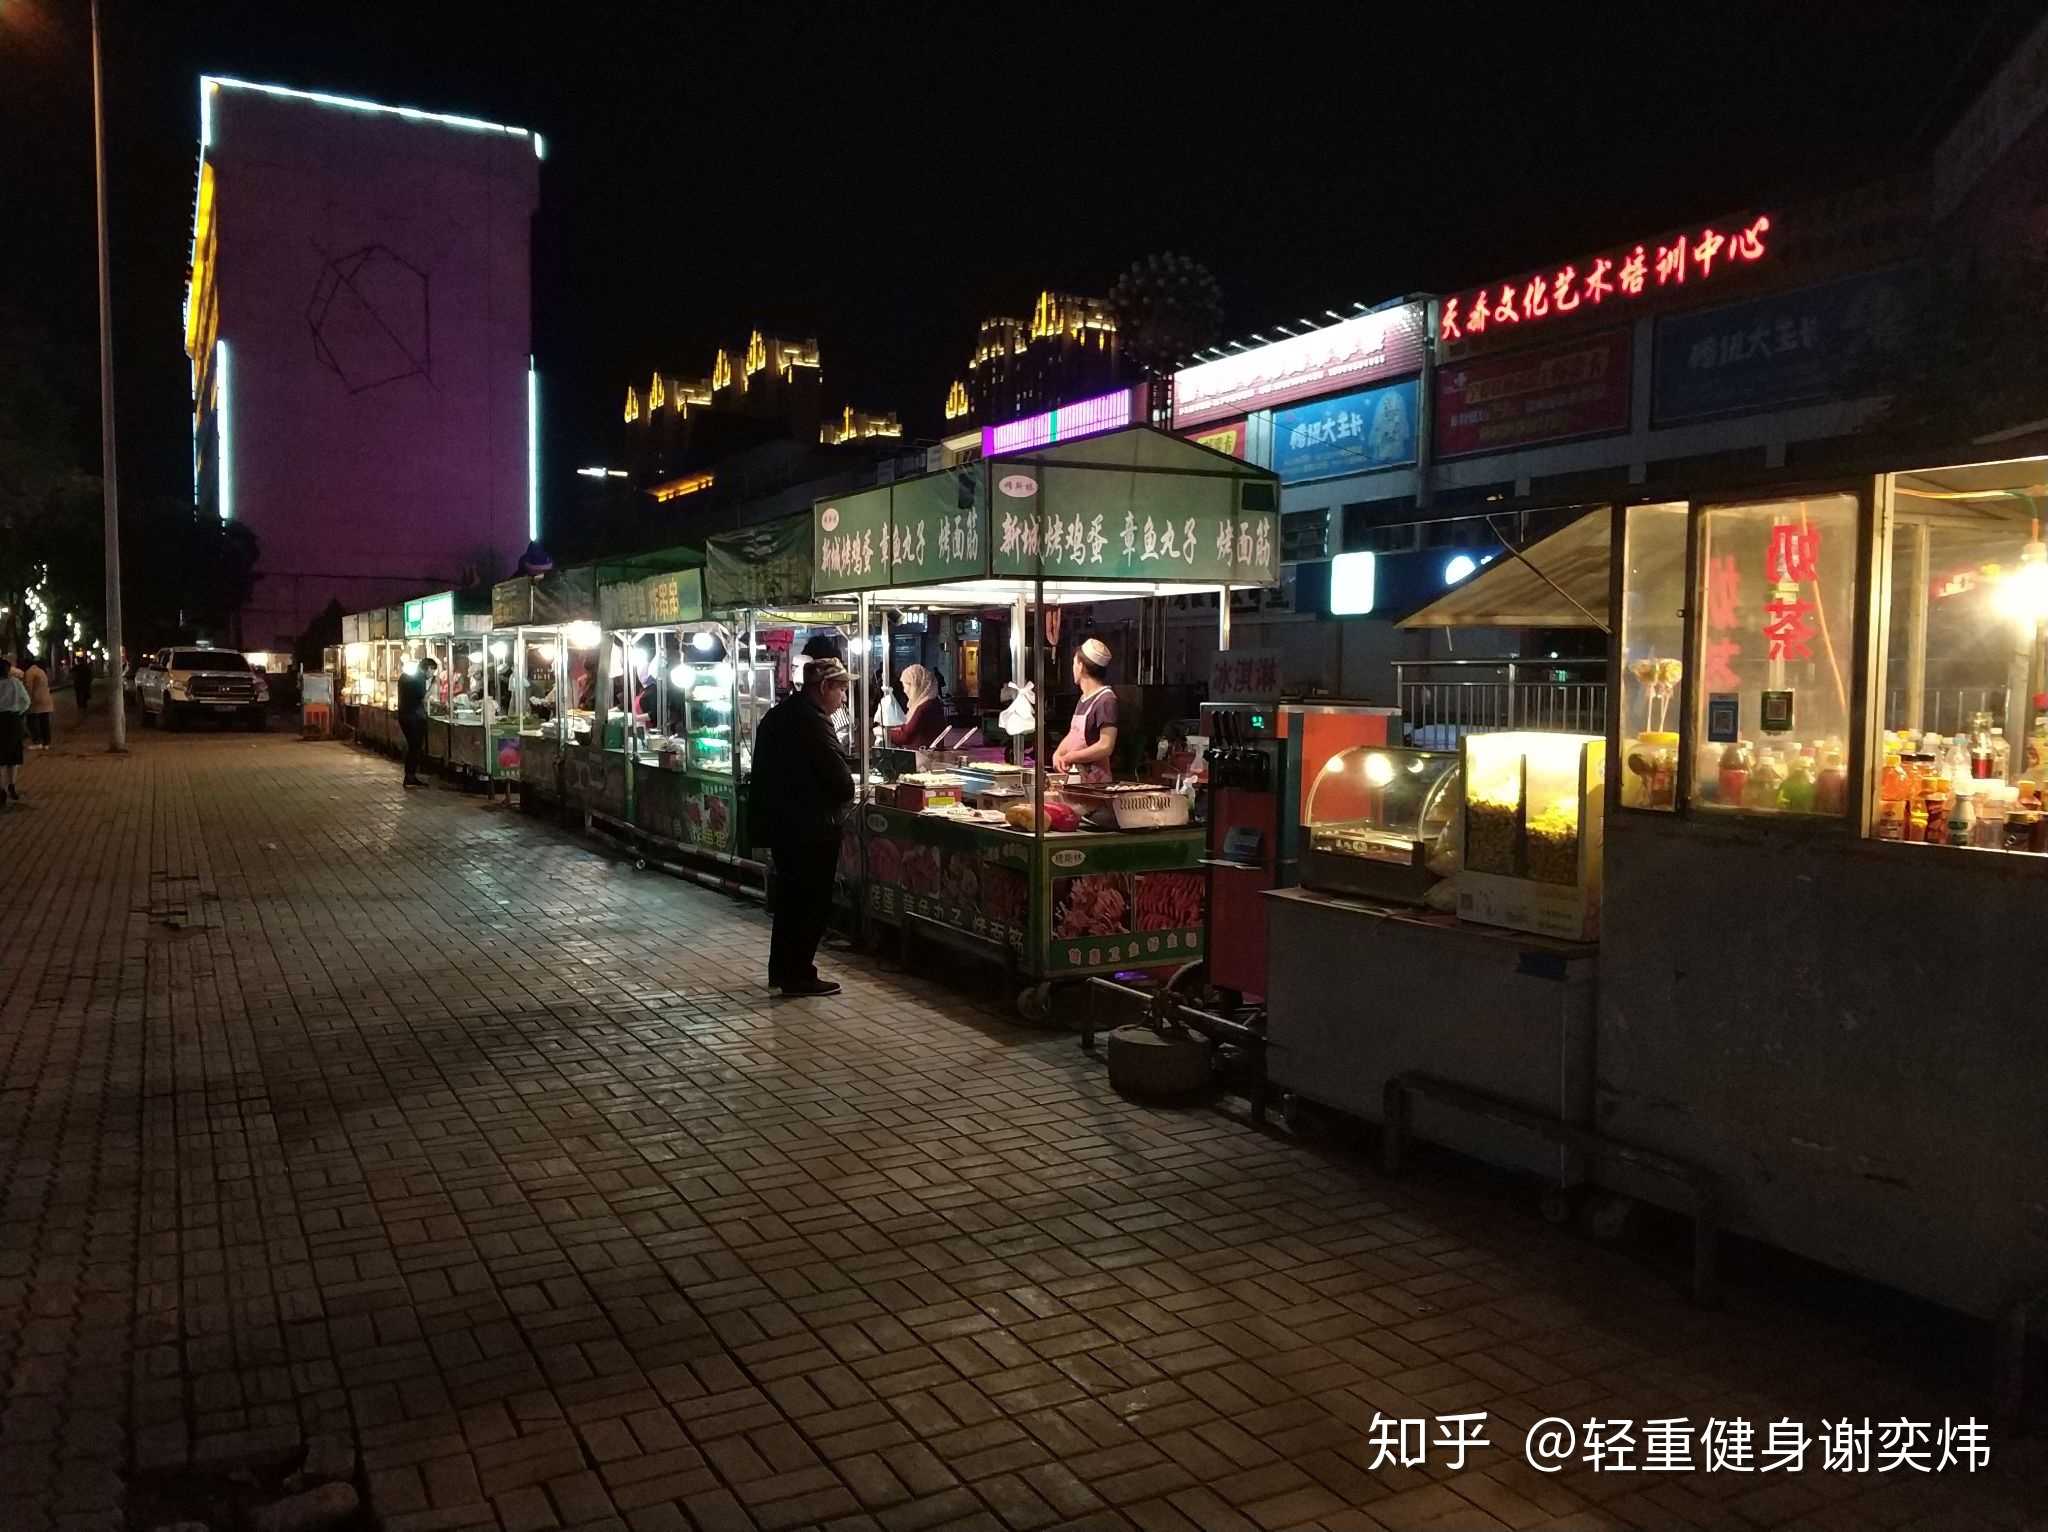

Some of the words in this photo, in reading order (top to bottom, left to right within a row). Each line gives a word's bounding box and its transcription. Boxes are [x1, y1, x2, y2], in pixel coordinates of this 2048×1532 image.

[938, 505, 979, 565] 烤面筋
[1119, 510, 1197, 568] 章鱼丸子
[1216, 516, 1271, 567] 烤面筋
